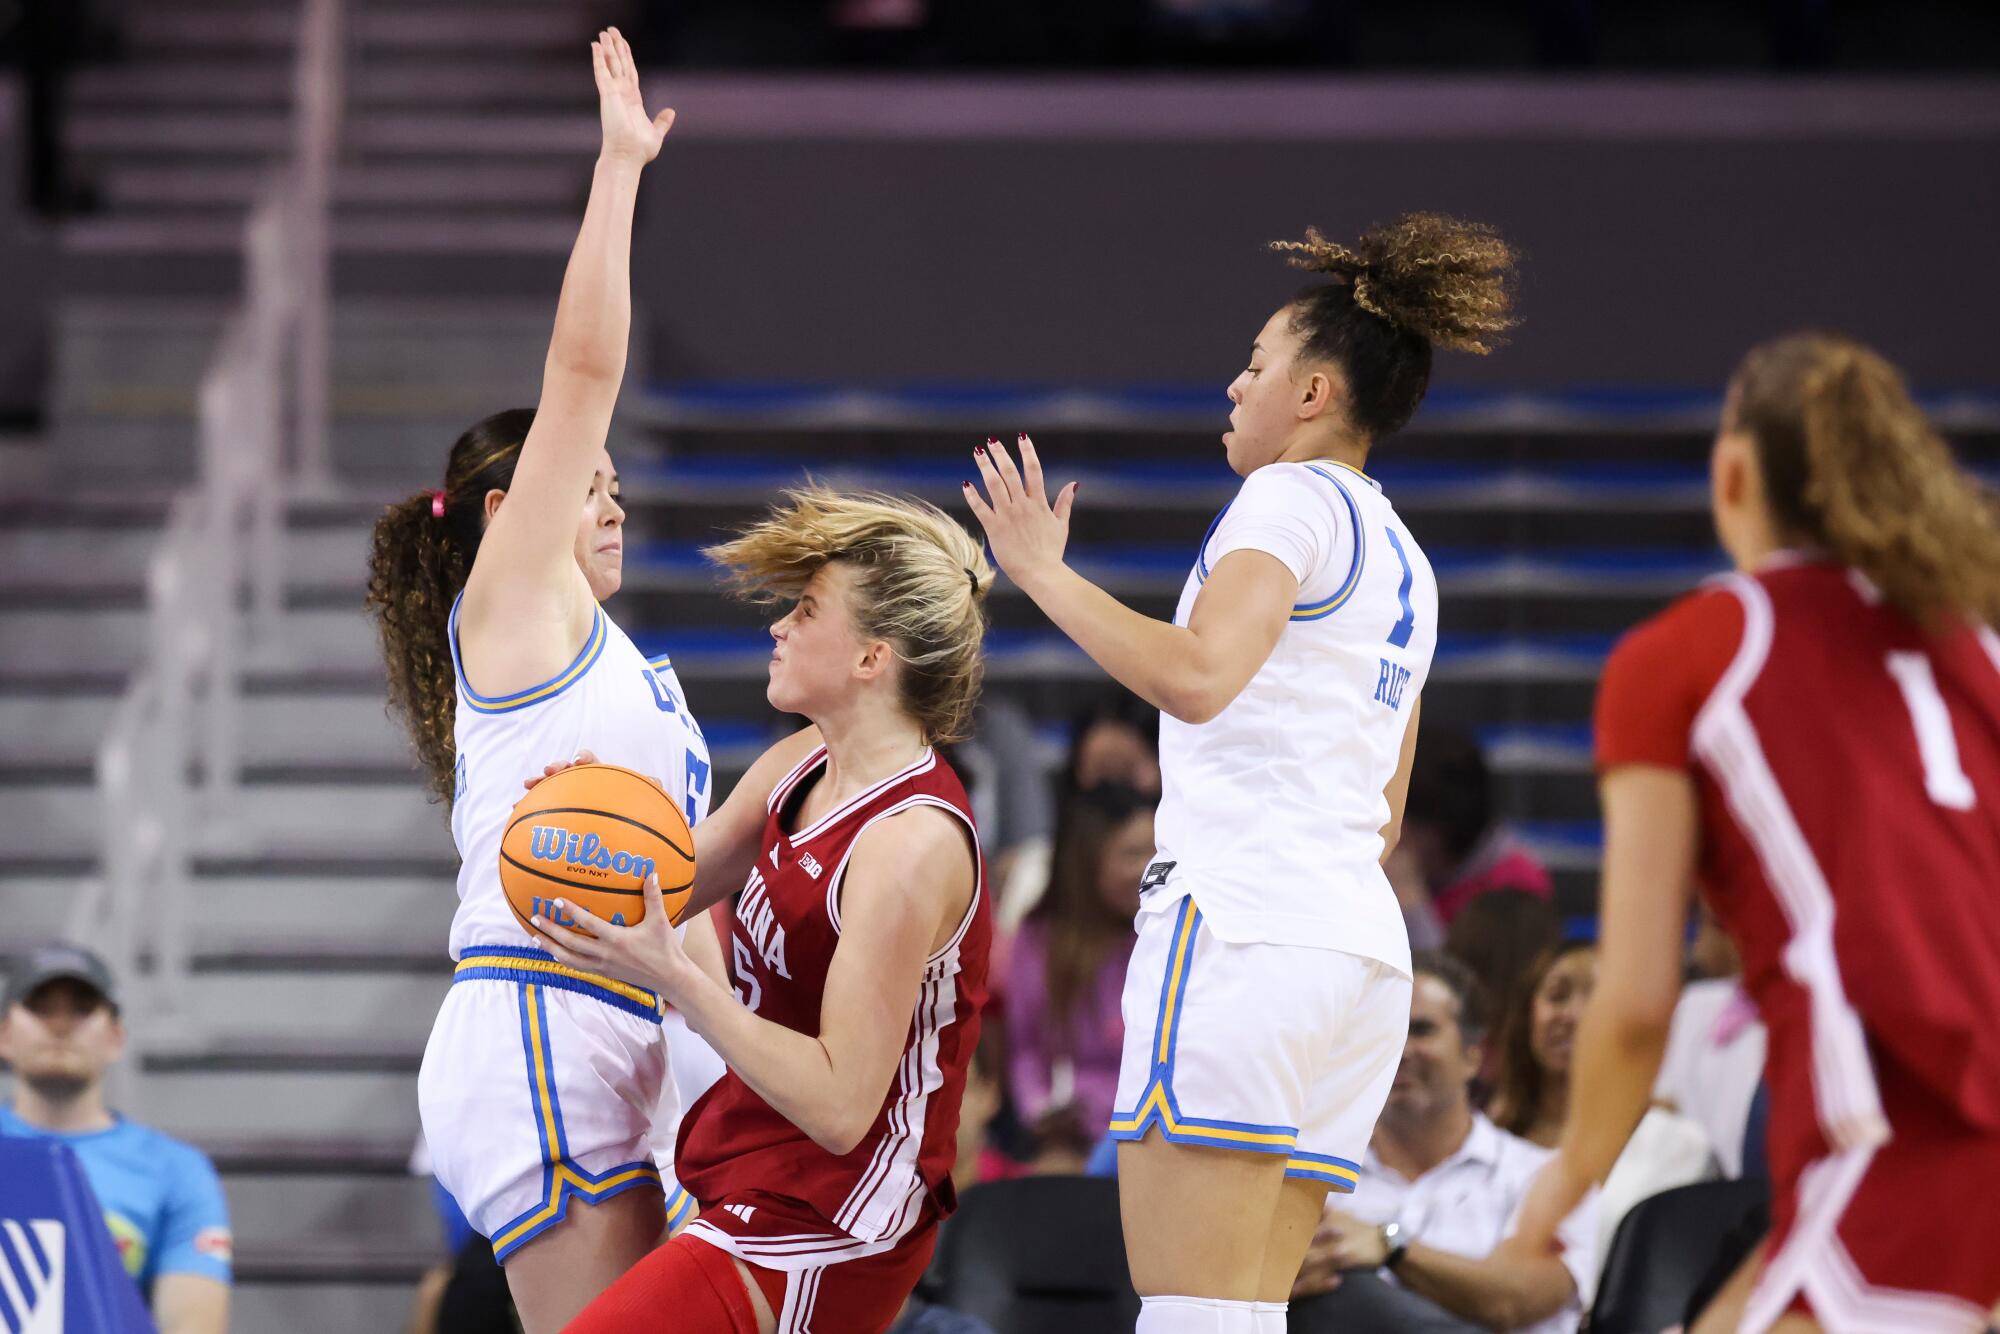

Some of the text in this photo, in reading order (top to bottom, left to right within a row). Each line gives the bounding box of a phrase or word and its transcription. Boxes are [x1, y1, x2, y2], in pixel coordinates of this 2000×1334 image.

[1385, 526, 1414, 649] 1
[1884, 649, 1976, 811] 1
[531, 824, 655, 880] Wilson
[566, 865, 609, 879] EVO NXT
